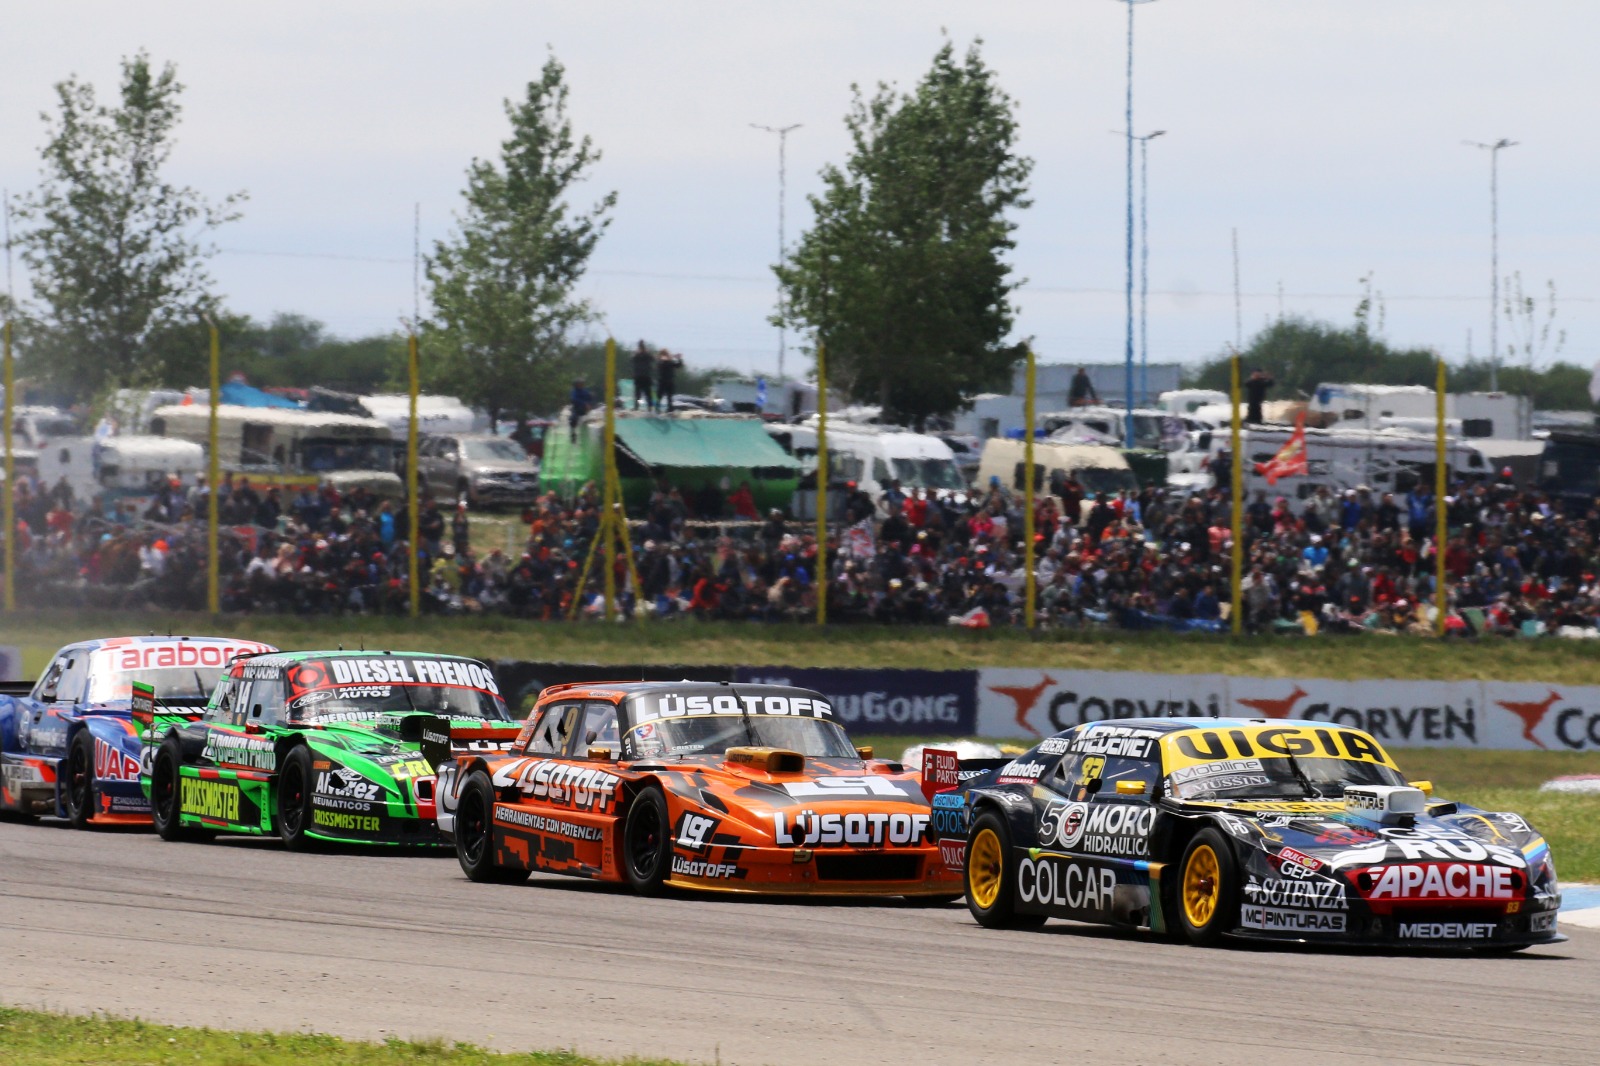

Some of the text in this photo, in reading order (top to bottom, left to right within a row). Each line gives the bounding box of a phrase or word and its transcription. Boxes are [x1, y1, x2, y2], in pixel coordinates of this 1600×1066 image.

[331, 659, 499, 695] DIESEL FRENOS
[339, 691, 391, 699] AUTOS
[95, 737, 141, 781] UAP
[936, 755, 956, 769] FLUID
[1000, 760, 1046, 778] Wander
[936, 770, 959, 785] PARTS
[1175, 761, 1259, 780] Mobiline
[180, 776, 239, 820] CROSSMASTER
[313, 796, 371, 811] NEUMATICOS
[314, 809, 380, 831] CROSSMASTER
[495, 805, 604, 841] HERRAMIENTAS CON POTENCIA
[774, 810, 930, 844] LÜSQTOF
[1083, 835, 1151, 856] HIDRAULICA
[1018, 858, 1117, 911] COLCAR
[1369, 864, 1513, 898] APACHE
[1260, 878, 1350, 910] SCIENZA
[1506, 902, 1520, 913] 83
[1399, 923, 1497, 938] MEDEMET
